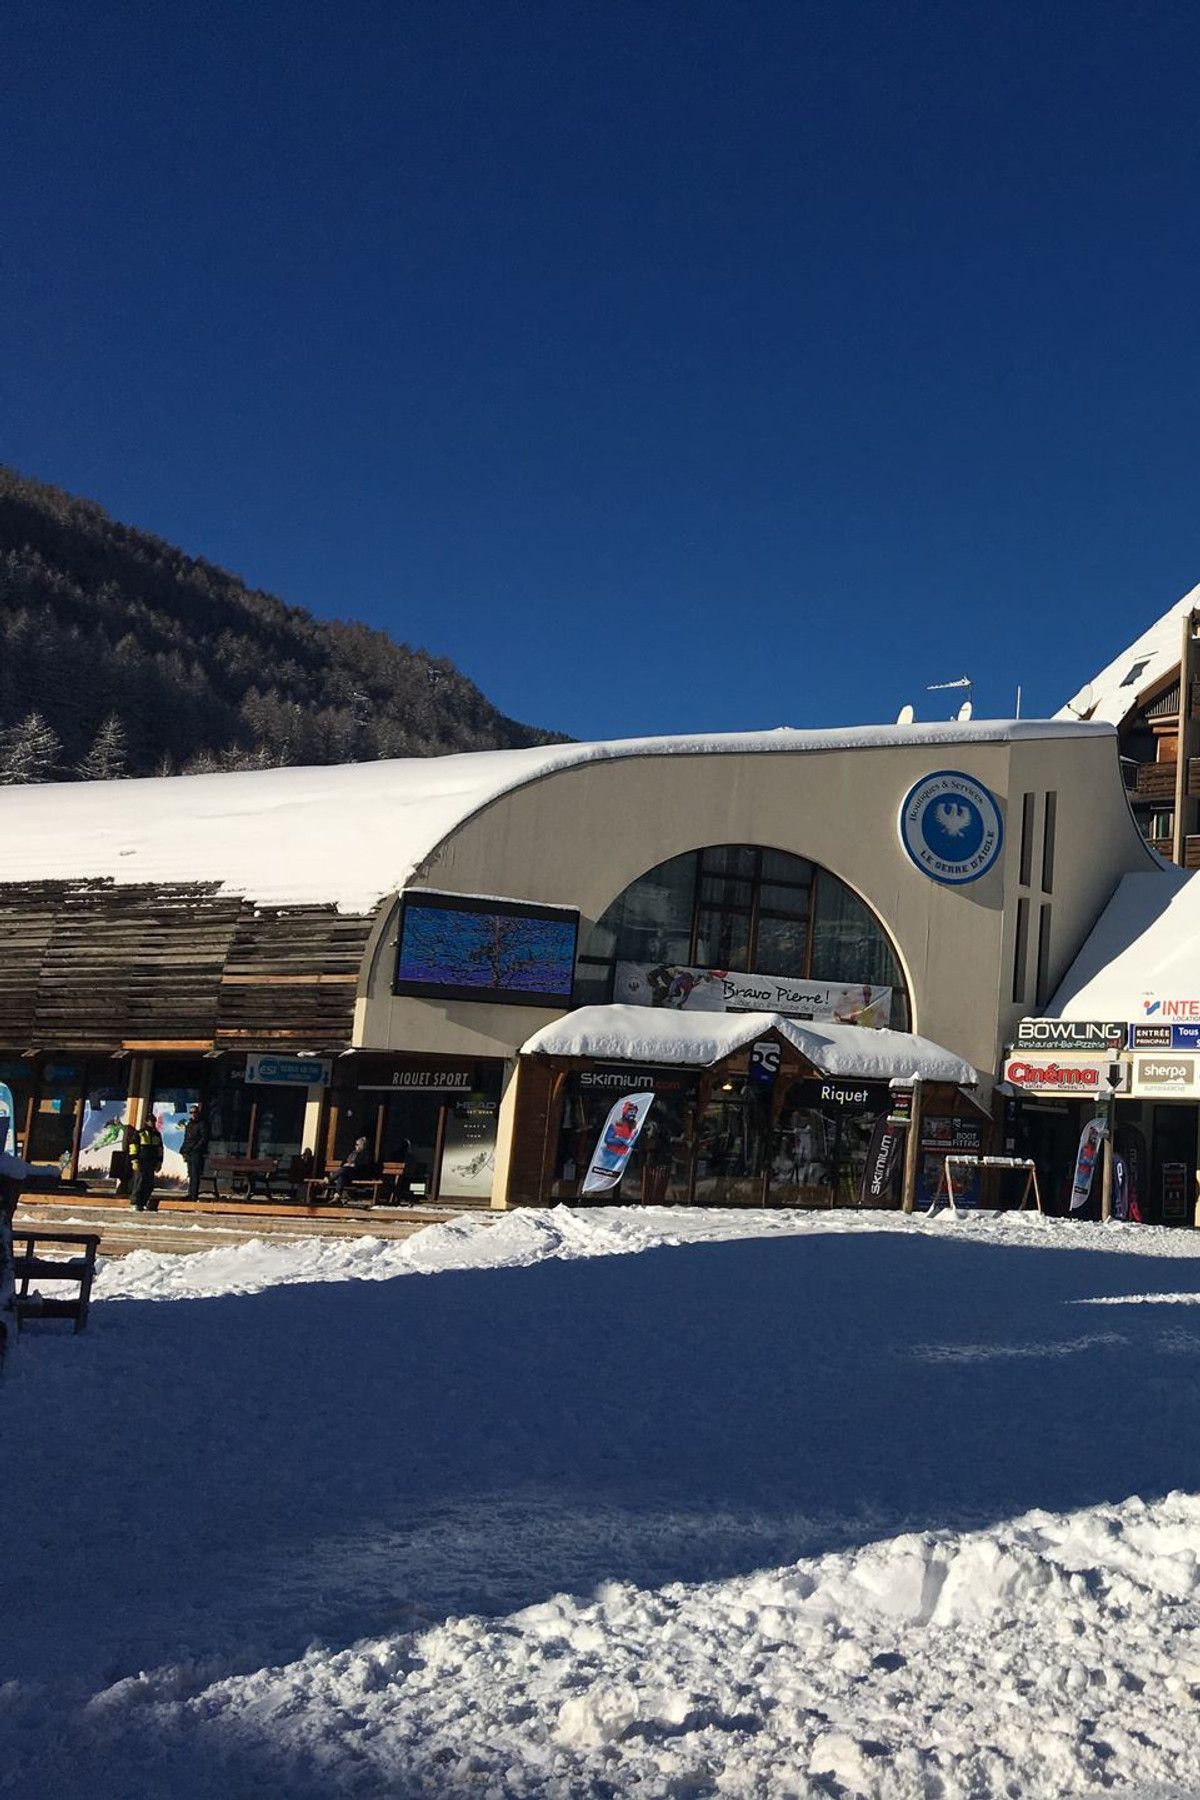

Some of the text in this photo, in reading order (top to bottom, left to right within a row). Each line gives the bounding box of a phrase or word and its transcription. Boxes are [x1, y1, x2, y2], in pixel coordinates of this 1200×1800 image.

[951, 781, 984, 805] Services
[920, 849, 934, 863] LE
[722, 979, 830, 1005] Bravo Pierre!
[1018, 1023, 1121, 1039] BOWLING
[1136, 1026, 1170, 1037] ENTRÉE
[1178, 1027, 1199, 1037] Tous
[1008, 1062, 1099, 1085] Cinéma
[1144, 1062, 1187, 1079] sherpa
[392, 1072, 469, 1087] RIQUET SPORT
[821, 1086, 869, 1105] Riquet
